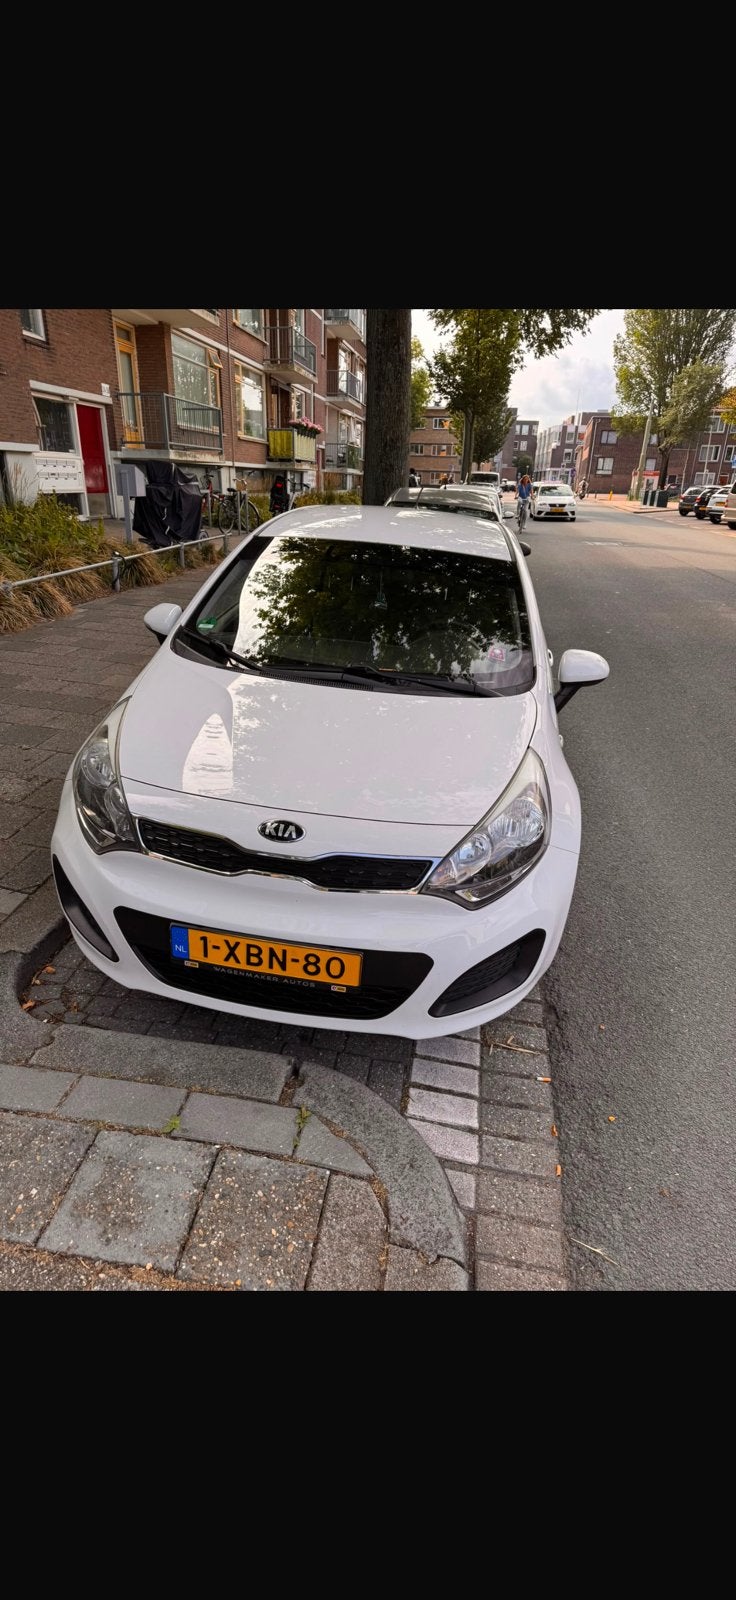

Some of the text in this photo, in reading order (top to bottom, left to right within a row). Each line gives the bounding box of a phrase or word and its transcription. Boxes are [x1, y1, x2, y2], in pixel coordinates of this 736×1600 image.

[264, 822, 297, 839] KIA
[175, 944, 187, 953] NL
[200, 935, 346, 979] 1-XBN-80
[213, 966, 316, 988] WAGENMAKER AUTOS
